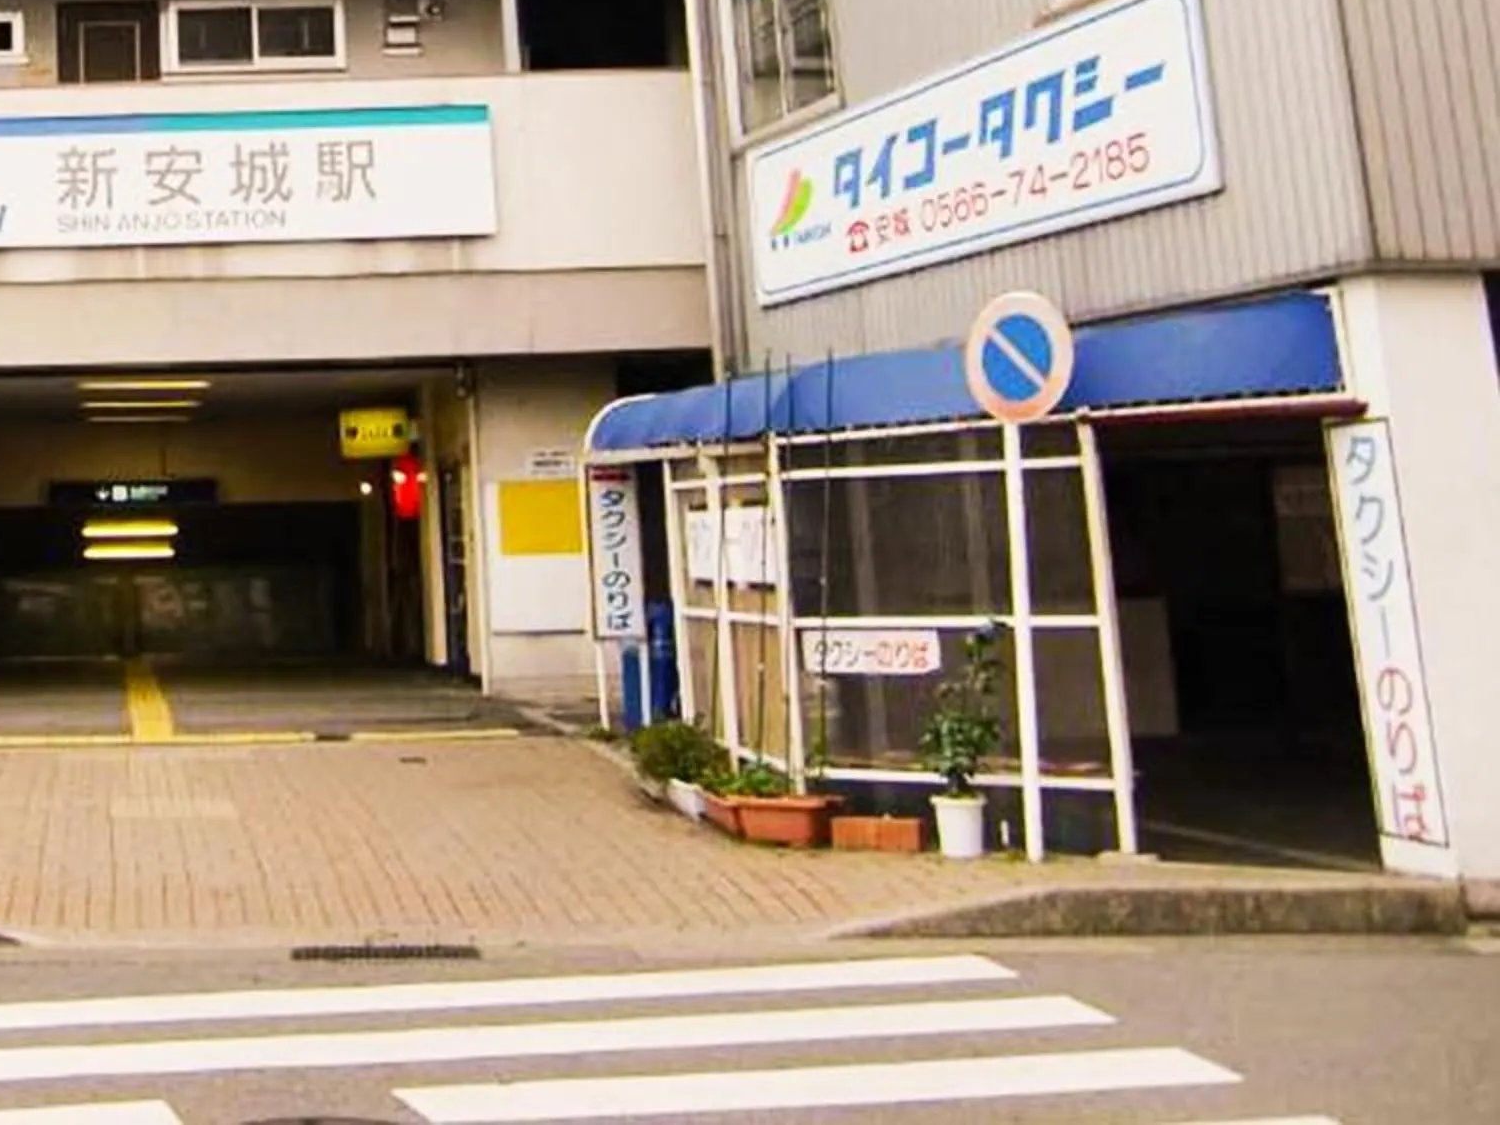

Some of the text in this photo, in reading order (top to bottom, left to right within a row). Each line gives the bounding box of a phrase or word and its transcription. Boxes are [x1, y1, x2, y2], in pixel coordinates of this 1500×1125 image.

[833, 55, 1166, 210] タイコータクシー
[55, 139, 377, 208] 新安城駅
[56, 208, 287, 233] SHIN ANJO STATION
[814, 640, 928, 668] タクシーのりば
[1346, 435, 1432, 843] タクシーのりば
